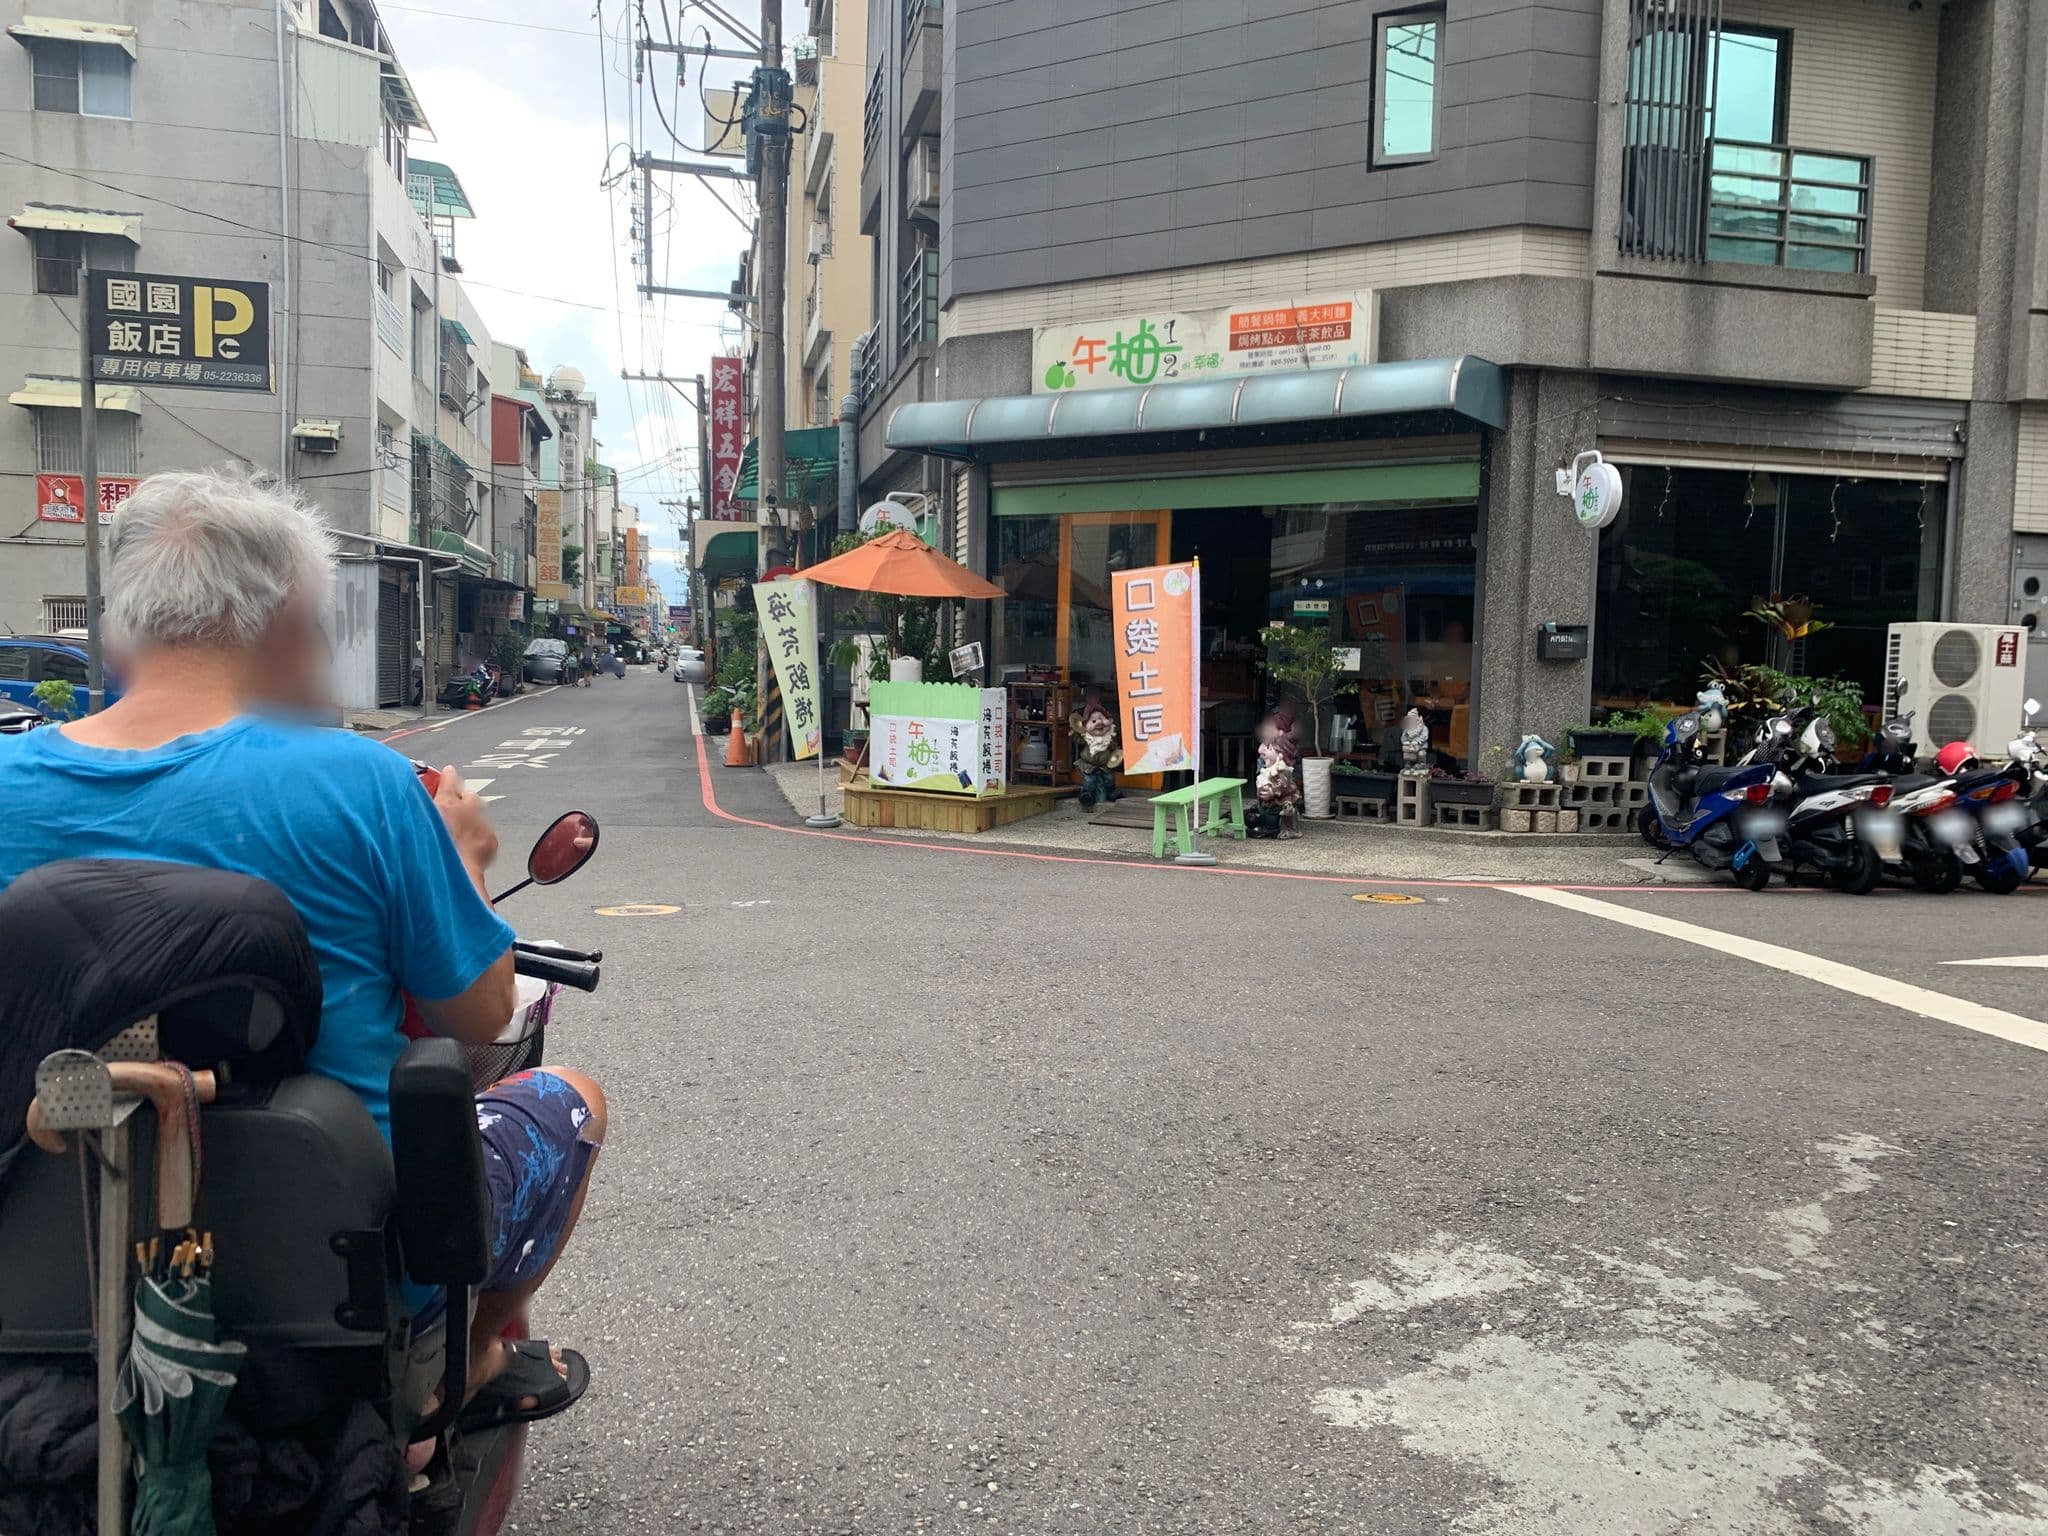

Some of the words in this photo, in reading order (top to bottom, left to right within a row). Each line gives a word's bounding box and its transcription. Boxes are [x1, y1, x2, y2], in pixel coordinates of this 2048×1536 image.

[107, 278, 180, 315] 國園
[107, 320, 182, 356] 飯店
[193, 285, 254, 358] P
[100, 357, 202, 381] 專用停車場
[203, 369, 262, 384] 05-2236336
[994, 707, 1003, 774] 口袋土司
